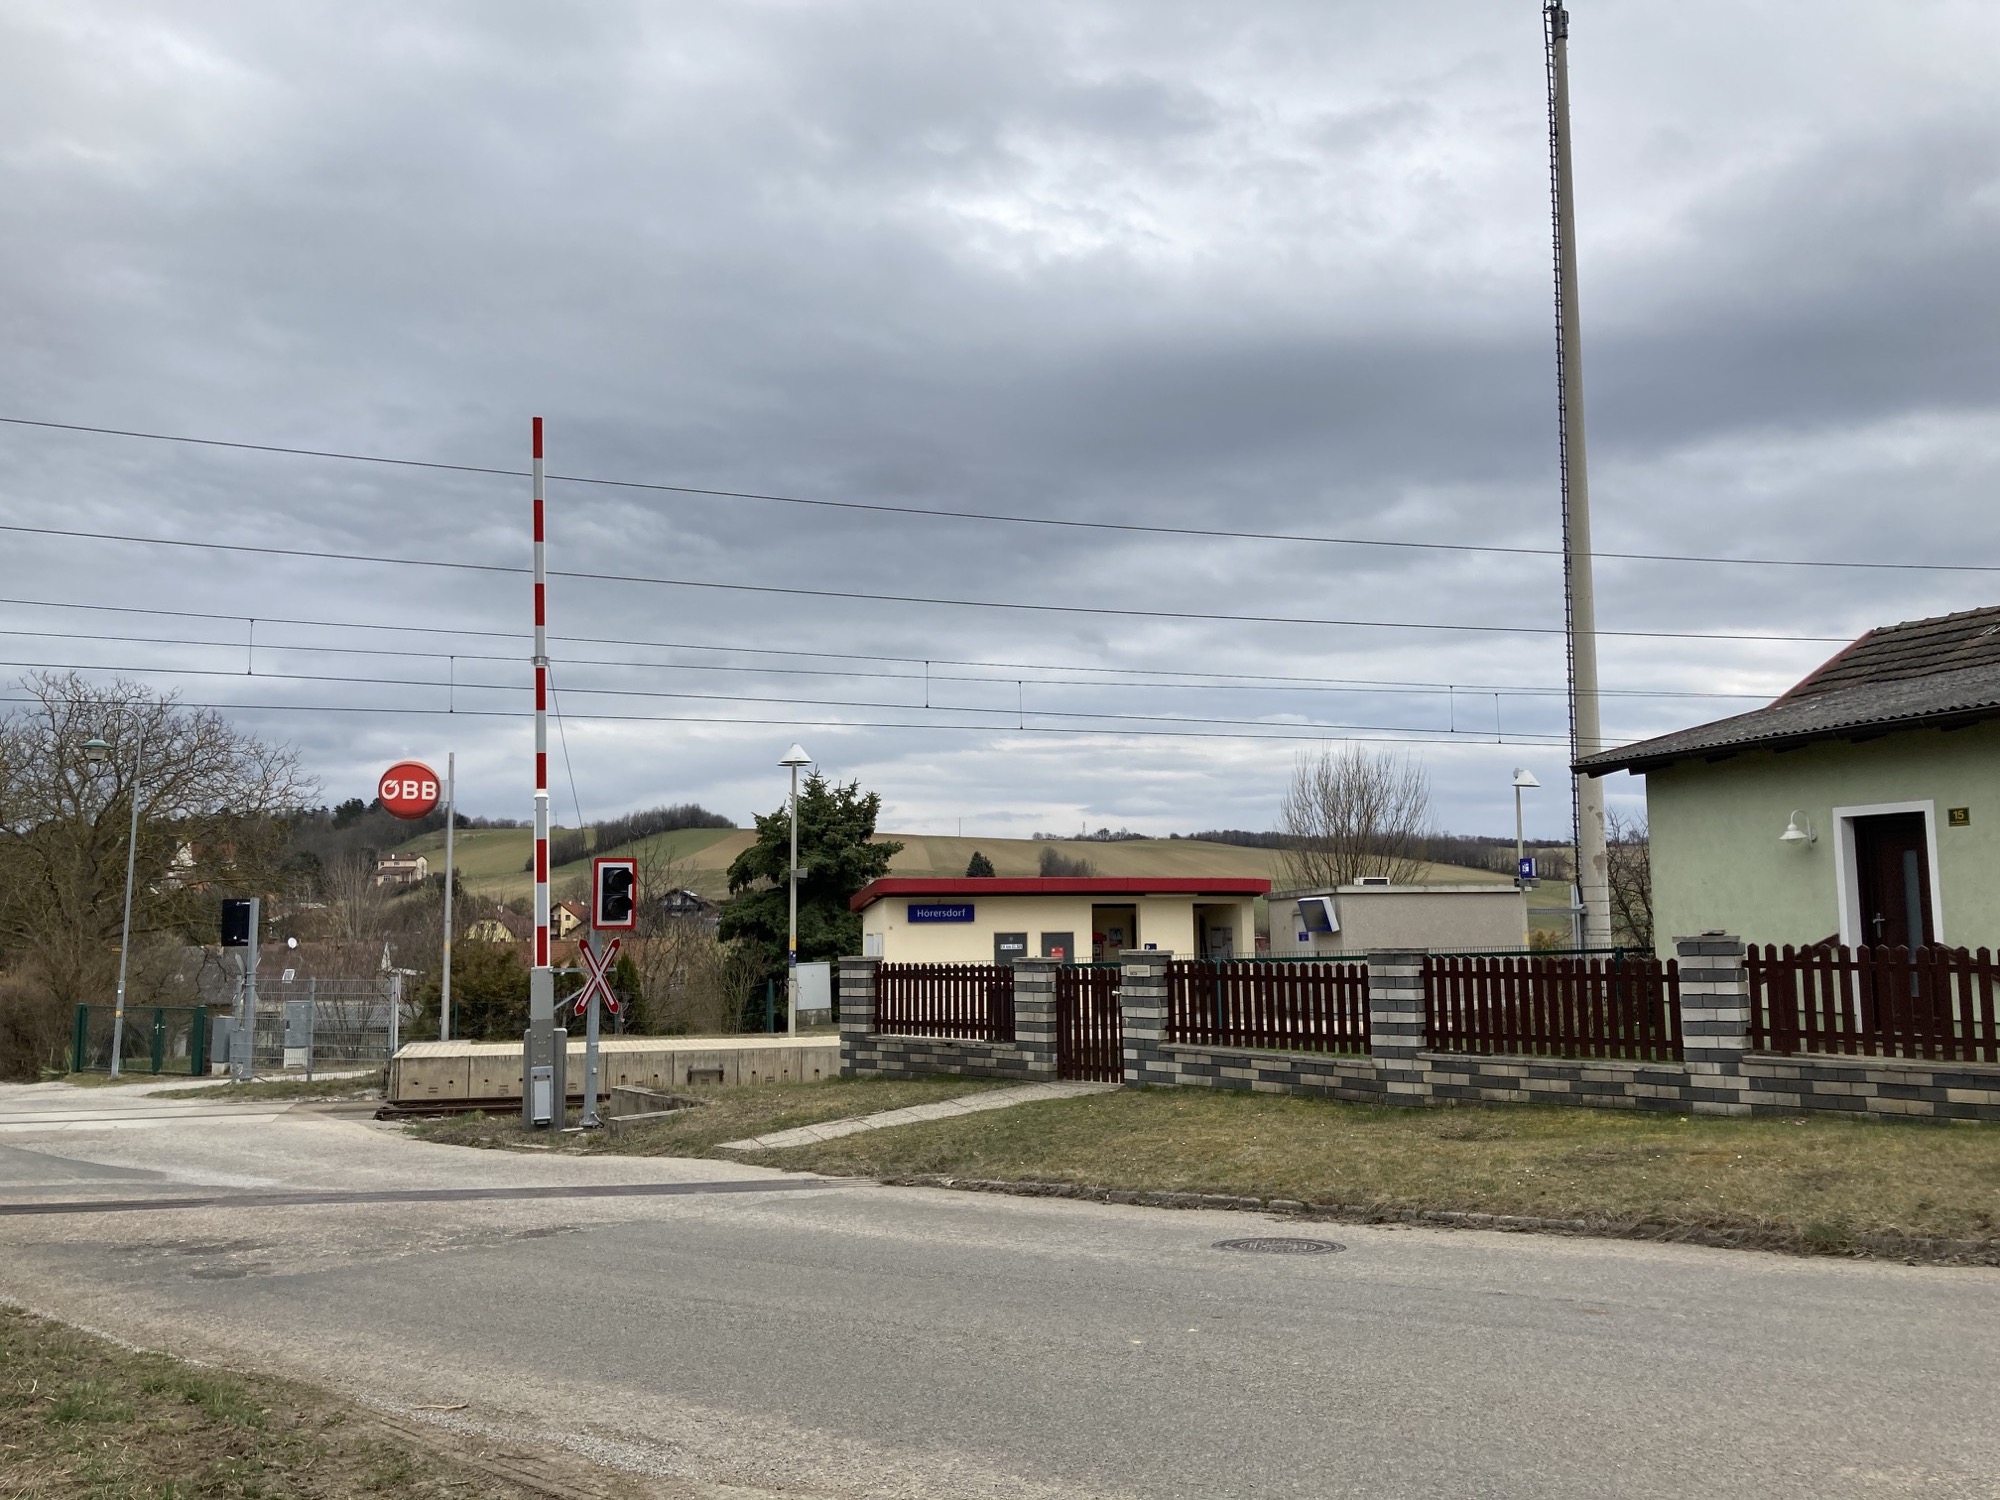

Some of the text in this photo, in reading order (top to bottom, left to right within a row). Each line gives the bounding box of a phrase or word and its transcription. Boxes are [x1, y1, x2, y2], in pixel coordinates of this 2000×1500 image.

[381, 780, 437, 800] ÖBB
[1953, 810, 1964, 820] 15
[917, 908, 966, 918] Hörersdorf
